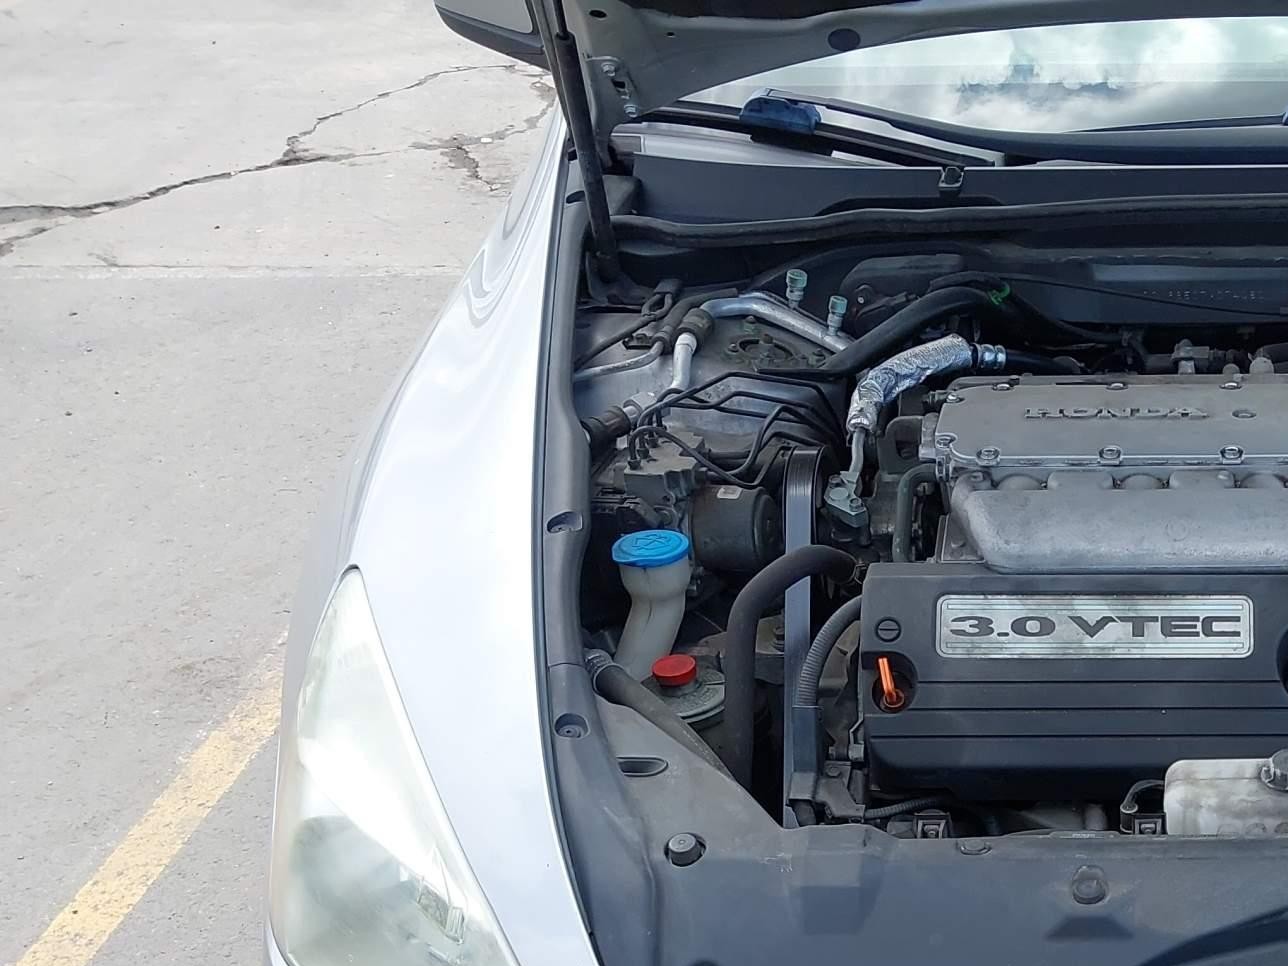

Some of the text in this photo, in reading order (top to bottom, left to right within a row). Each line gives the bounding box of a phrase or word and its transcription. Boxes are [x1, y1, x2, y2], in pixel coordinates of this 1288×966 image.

[1024, 407, 1209, 419] HONDA
[950, 616, 1241, 638] 3.0 VTEC
